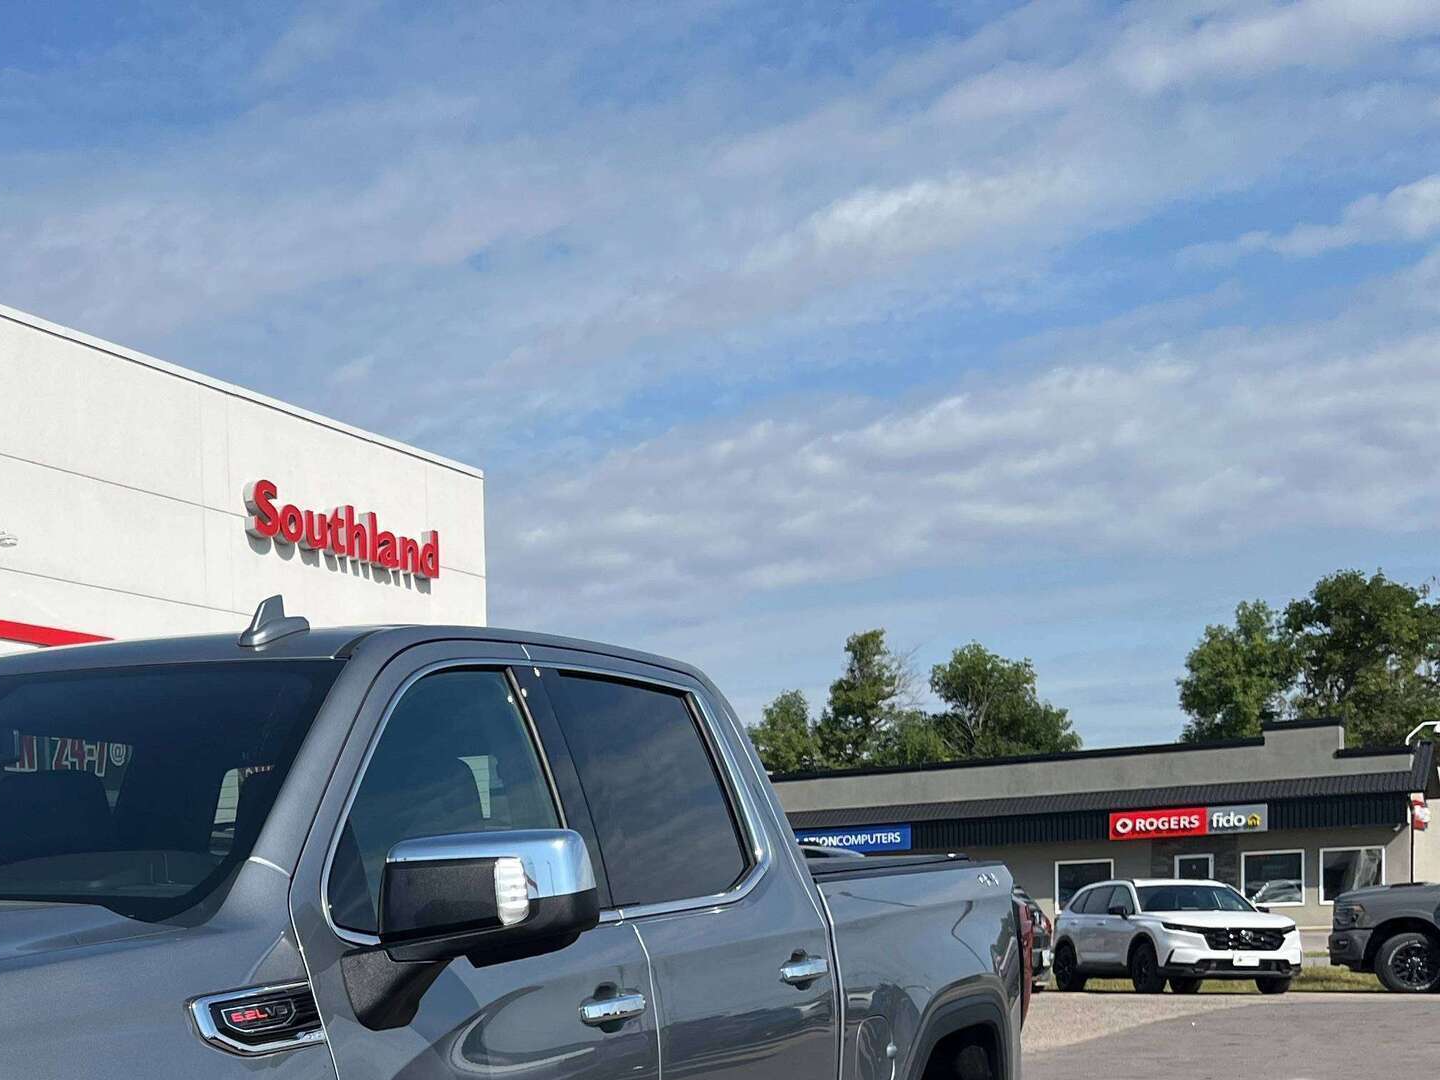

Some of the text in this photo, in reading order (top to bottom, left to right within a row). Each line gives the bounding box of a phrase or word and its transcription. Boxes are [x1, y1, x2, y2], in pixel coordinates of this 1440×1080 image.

[244, 479, 440, 579] Southland
[1134, 811, 1246, 832] ROGERS fido
